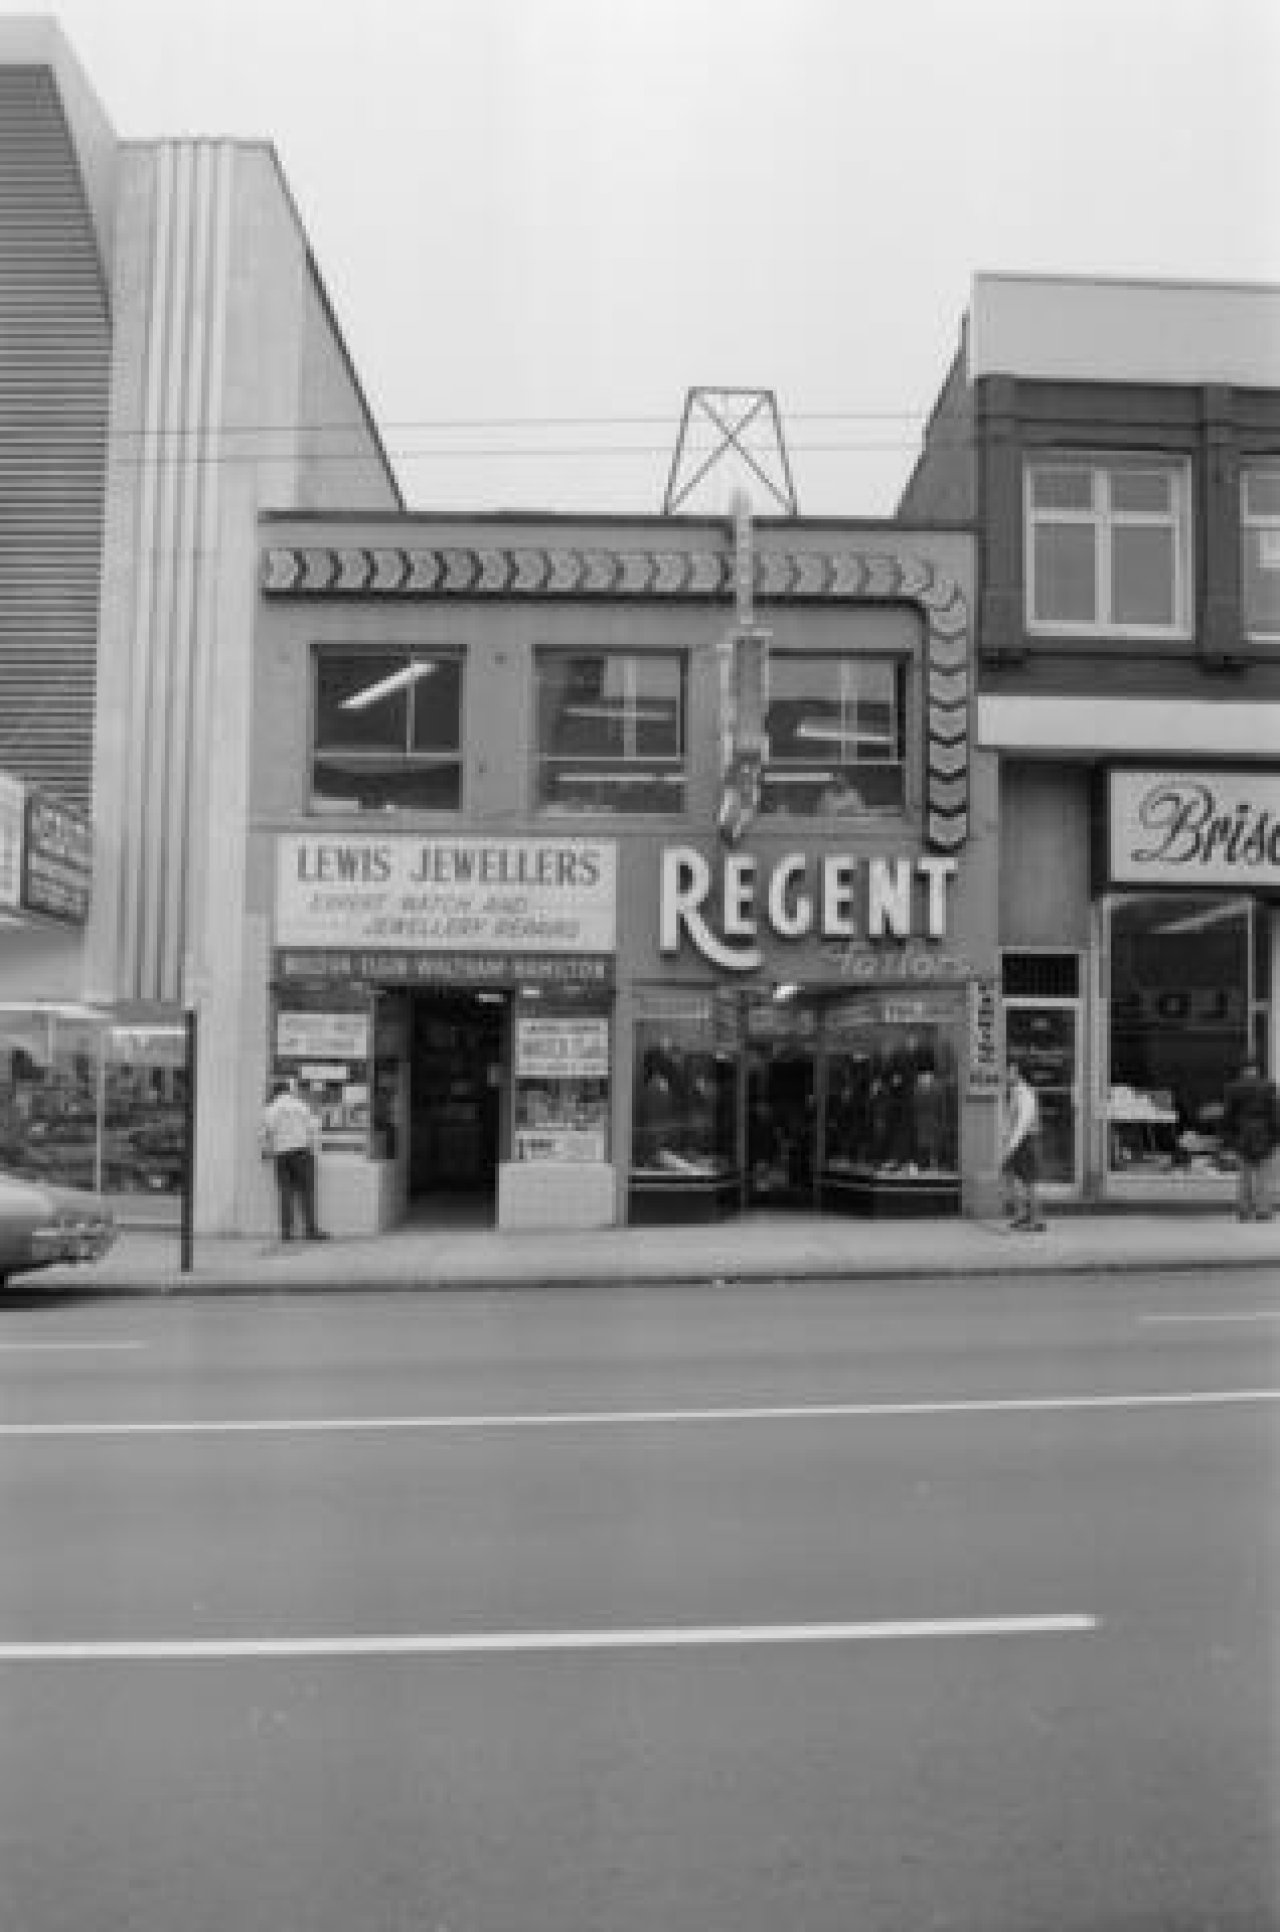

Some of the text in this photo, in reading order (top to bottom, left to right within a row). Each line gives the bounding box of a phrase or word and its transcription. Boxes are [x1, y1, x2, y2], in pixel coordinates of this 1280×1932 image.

[297, 844, 601, 886] LEWIS JEWELLERS
[659, 846, 958, 969] REGENT
